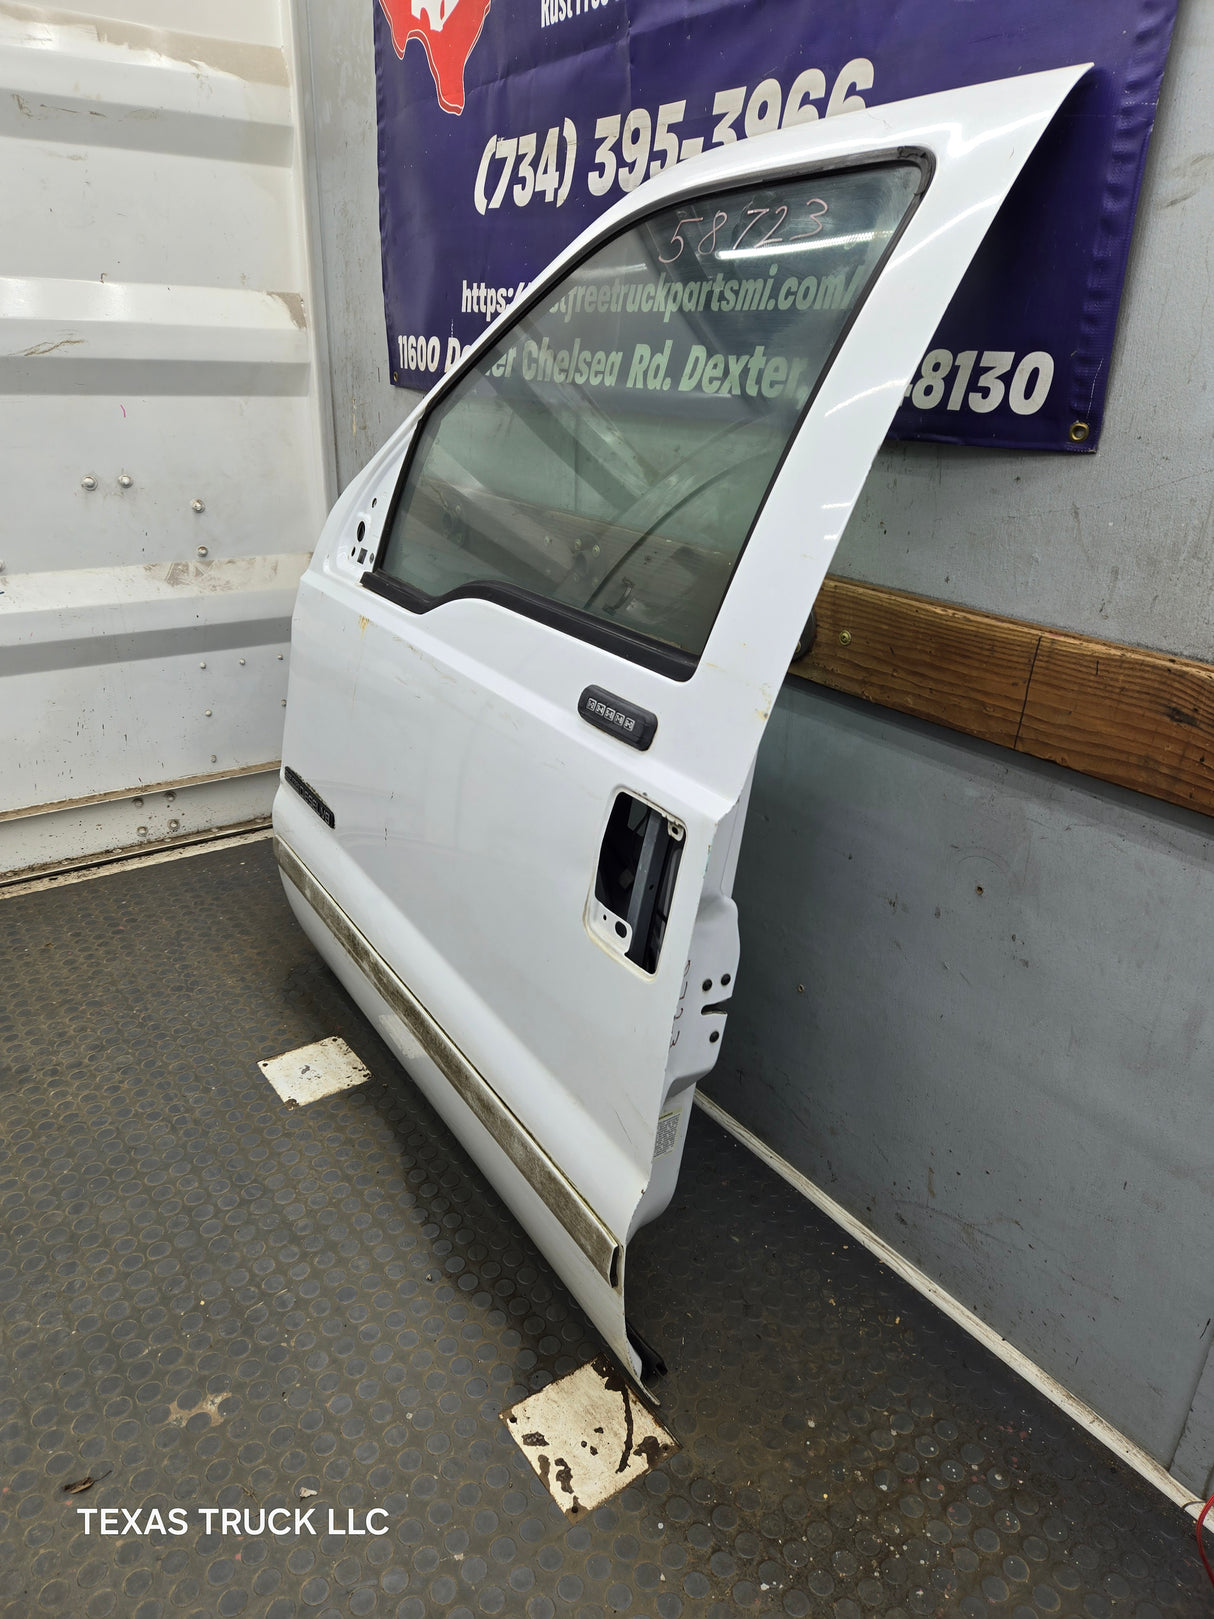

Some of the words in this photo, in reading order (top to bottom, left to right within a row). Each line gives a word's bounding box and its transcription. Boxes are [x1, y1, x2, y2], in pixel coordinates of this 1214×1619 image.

[474, 117, 578, 216] (734)
[588, 57, 875, 197] 395-3966
[658, 198, 828, 264] 58723
[398, 335, 440, 373] 11600
[444, 337, 516, 378] Der
[522, 337, 623, 387] Chelsea
[626, 340, 673, 391] Rd.
[901, 348, 1055, 416] 8130
